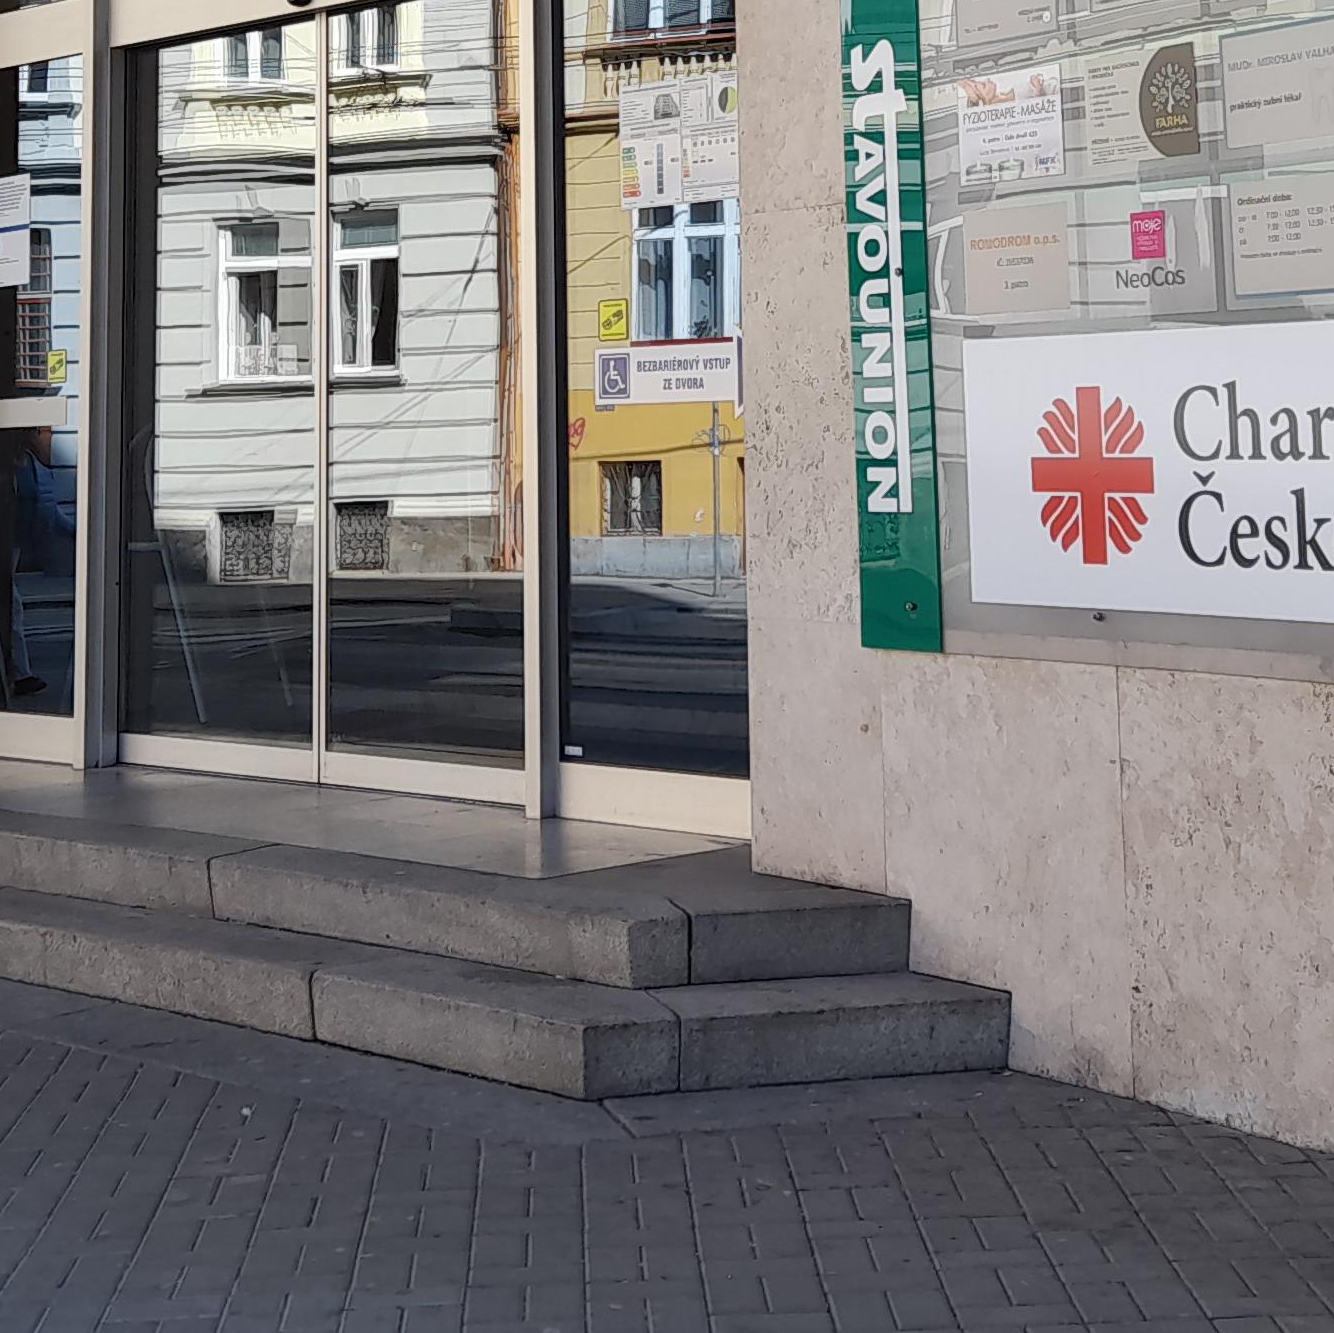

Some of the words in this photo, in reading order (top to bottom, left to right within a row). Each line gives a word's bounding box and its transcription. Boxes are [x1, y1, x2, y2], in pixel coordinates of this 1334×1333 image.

[1229, 97, 1261, 113] praktický
[1155, 114, 1189, 128] FARHA
[1116, 266, 1185, 289] NeoCos
[637, 355, 699, 373] BEZBARIÉROVÝ
[703, 357, 731, 371] VSTUP
[662, 378, 672, 390] ZE
[675, 377, 704, 390] DVORA
